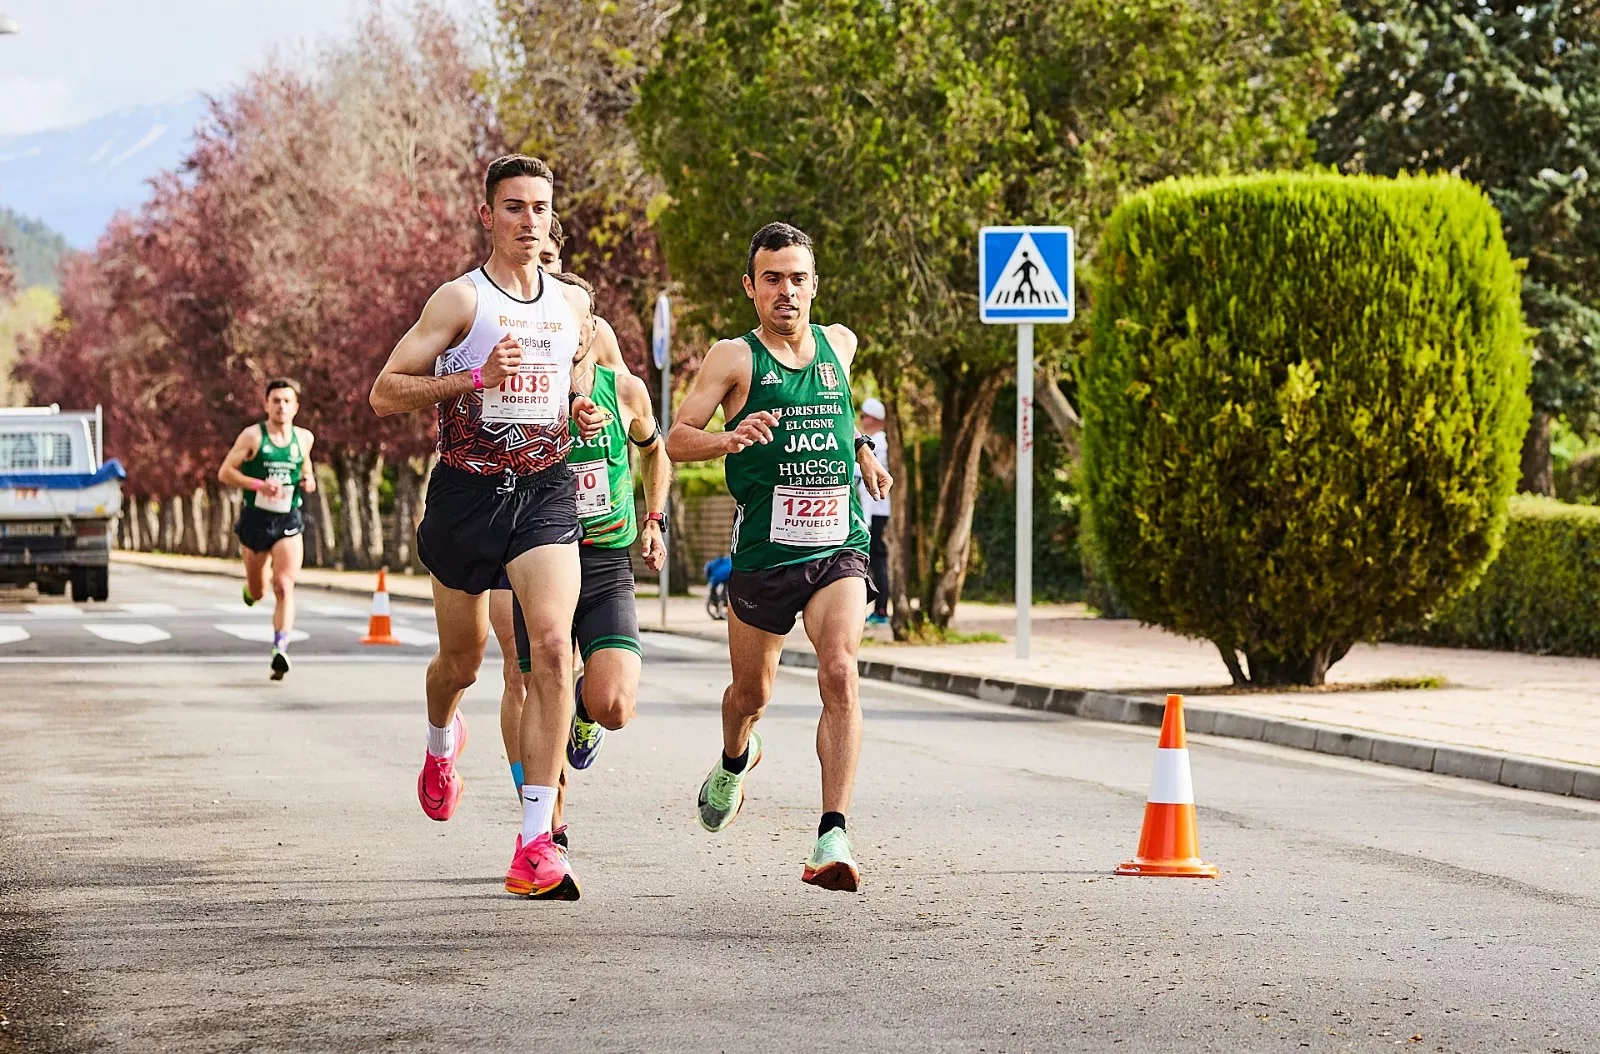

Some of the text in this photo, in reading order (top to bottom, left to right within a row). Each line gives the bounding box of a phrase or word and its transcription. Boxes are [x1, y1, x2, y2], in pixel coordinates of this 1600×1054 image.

[499, 374, 550, 393] 1039
[501, 395, 549, 404] ROBERTO
[785, 418, 835, 431] EL CISNE
[784, 432, 839, 452] JACA
[782, 498, 839, 517] 1222
[784, 518, 839, 528] PUYUELO 2
